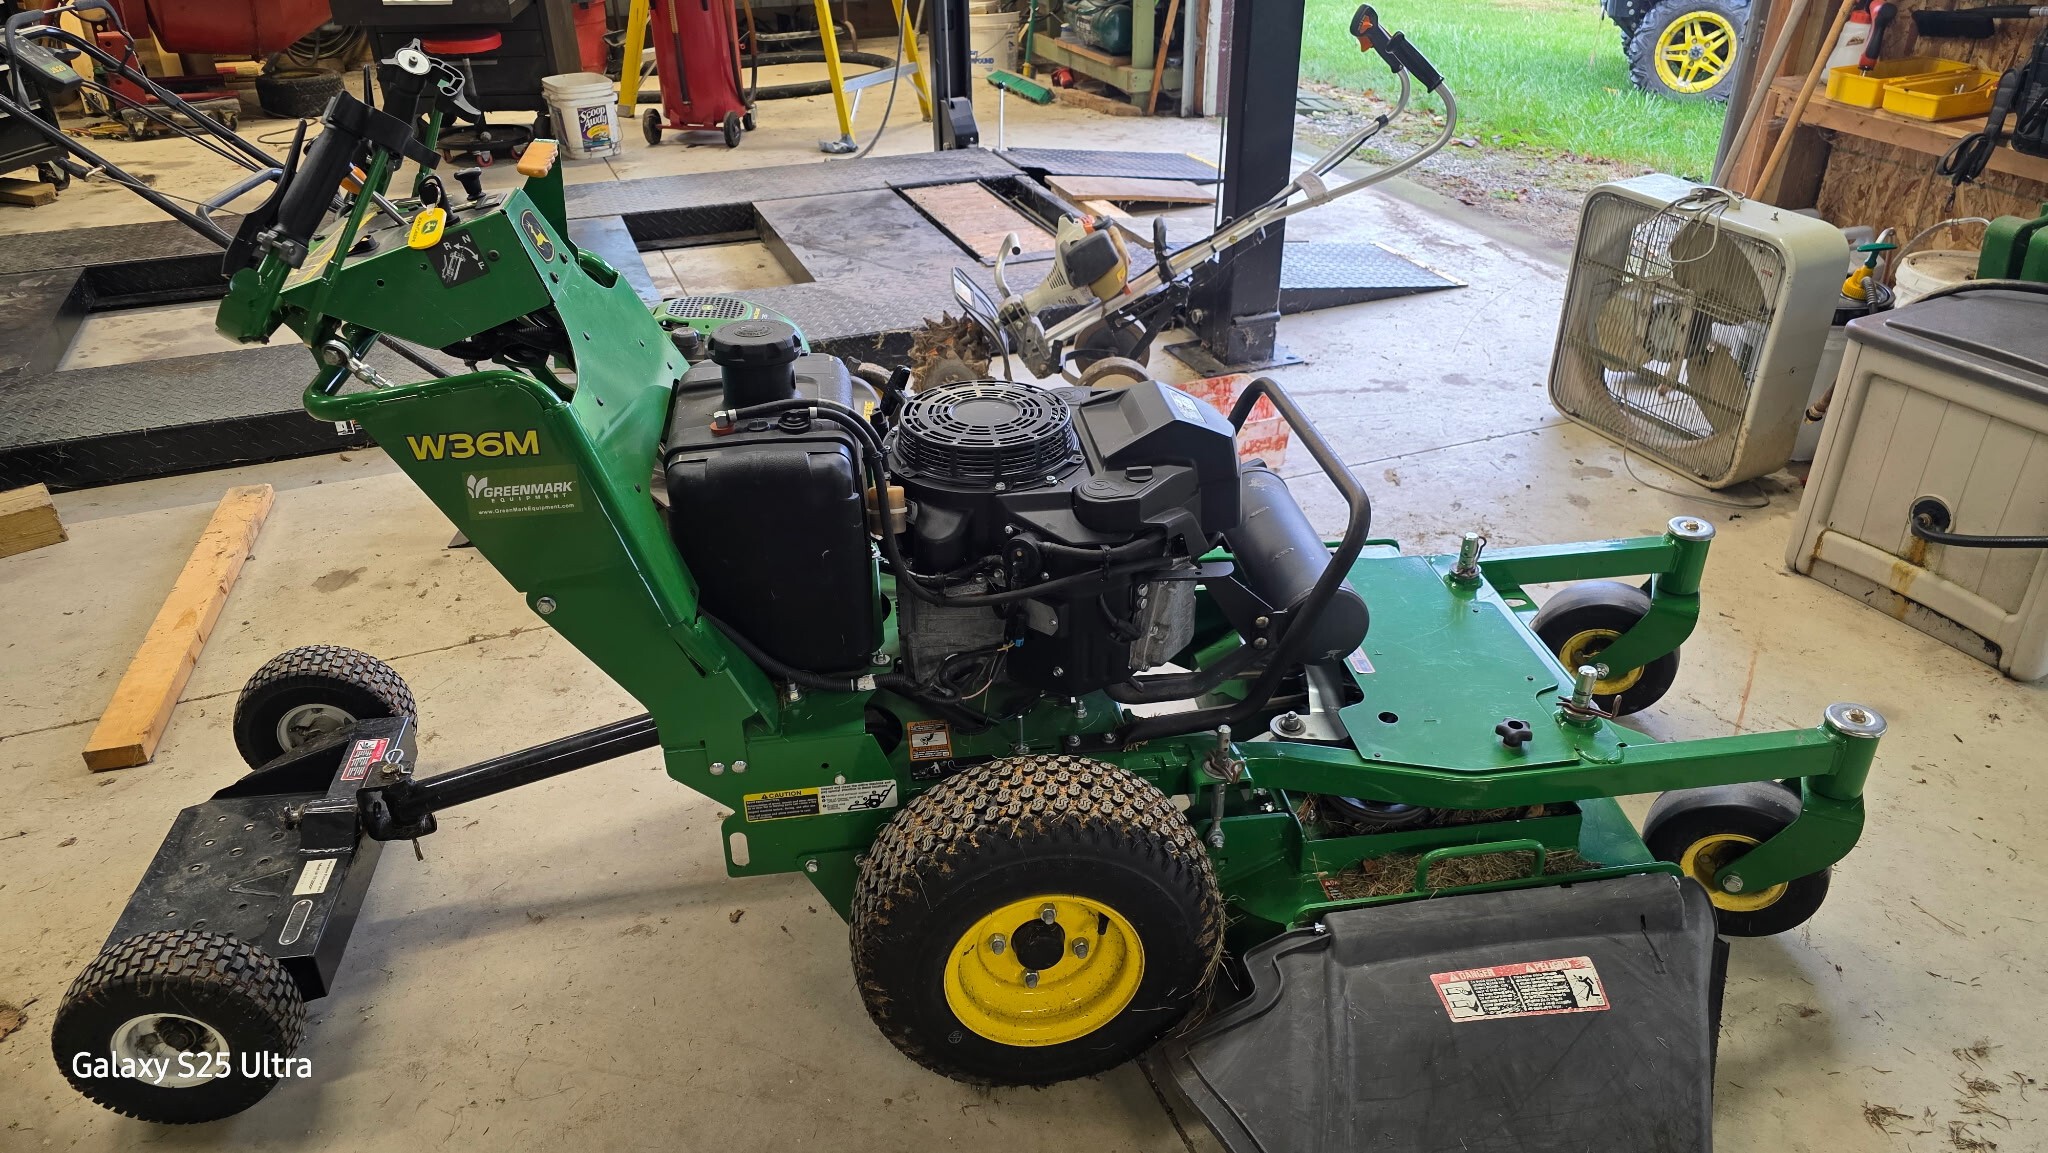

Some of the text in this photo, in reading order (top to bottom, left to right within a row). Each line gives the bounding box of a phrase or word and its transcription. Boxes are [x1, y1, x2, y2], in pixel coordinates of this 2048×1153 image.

[580, 107, 605, 123] Scoop
[583, 115, 606, 132] Away
[461, 234, 472, 244] N
[443, 242, 452, 251] R
[477, 261, 485, 271] F
[405, 429, 541, 461] W36M
[483, 481, 573, 498] GREENMARK
[491, 493, 567, 503] EQUIPMENT
[478, 503, 575, 516] www.GreenMarkEquipment.com
[769, 790, 802, 799] CAUTION
[1458, 968, 1495, 981] DANGER
